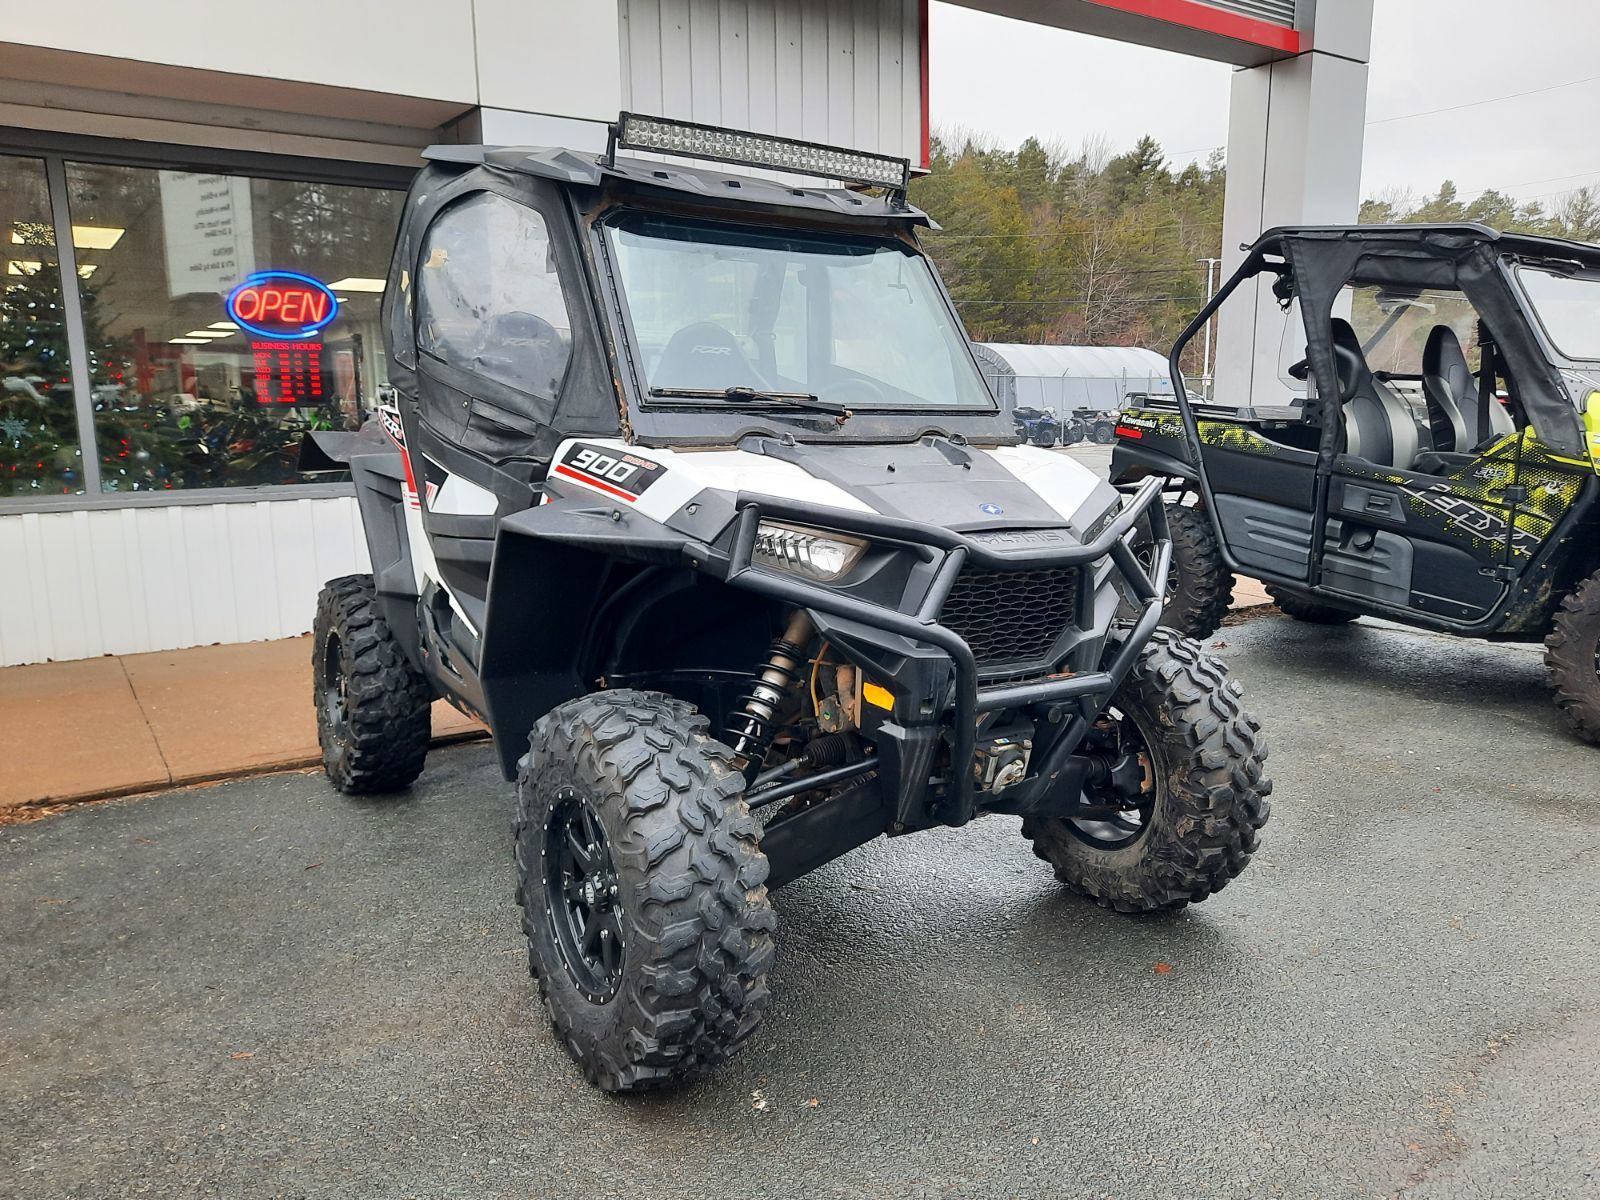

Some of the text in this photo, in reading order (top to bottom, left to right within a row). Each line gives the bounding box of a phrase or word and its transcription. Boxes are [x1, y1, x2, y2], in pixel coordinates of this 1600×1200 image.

[235, 289, 326, 322] OPEN
[252, 342, 323, 351] BUSINESS HOURS
[690, 344, 731, 355] RZR
[1121, 414, 1157, 429] Kawasaki
[570, 449, 638, 482] 900
